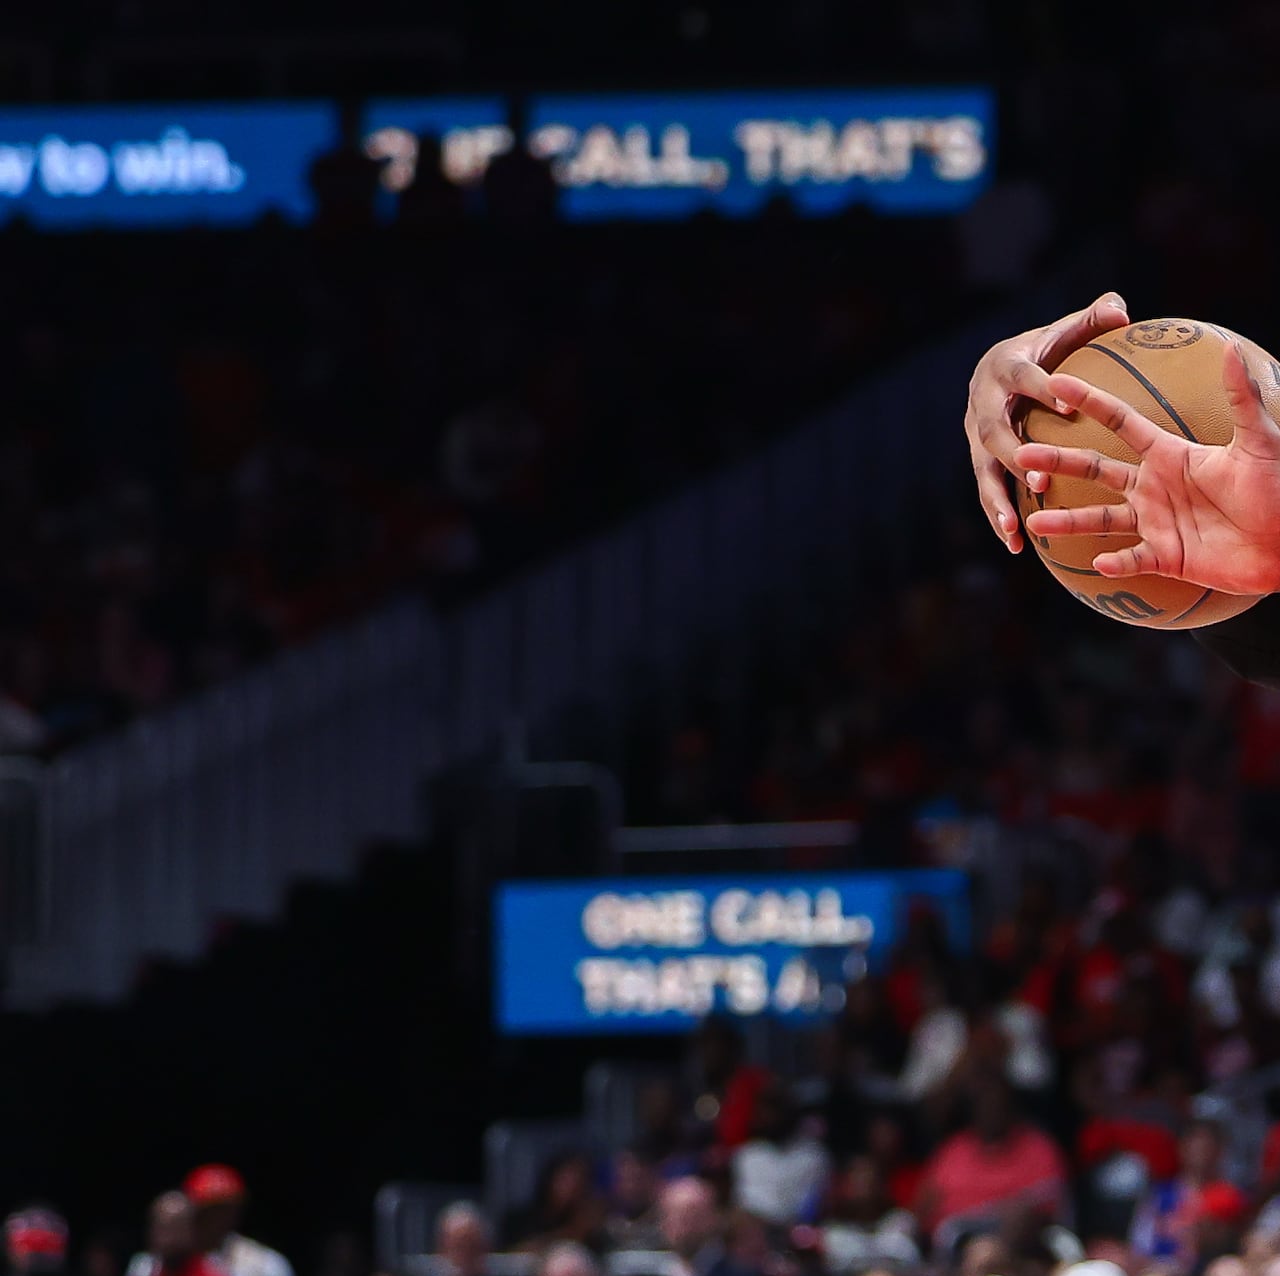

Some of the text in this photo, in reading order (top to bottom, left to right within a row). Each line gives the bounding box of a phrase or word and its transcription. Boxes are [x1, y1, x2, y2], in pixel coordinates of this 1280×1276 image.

[40, 135, 110, 197] to
[733, 116, 983, 186] THAT'S
[583, 890, 707, 950] ONE
[576, 953, 769, 1018] THAT'S
